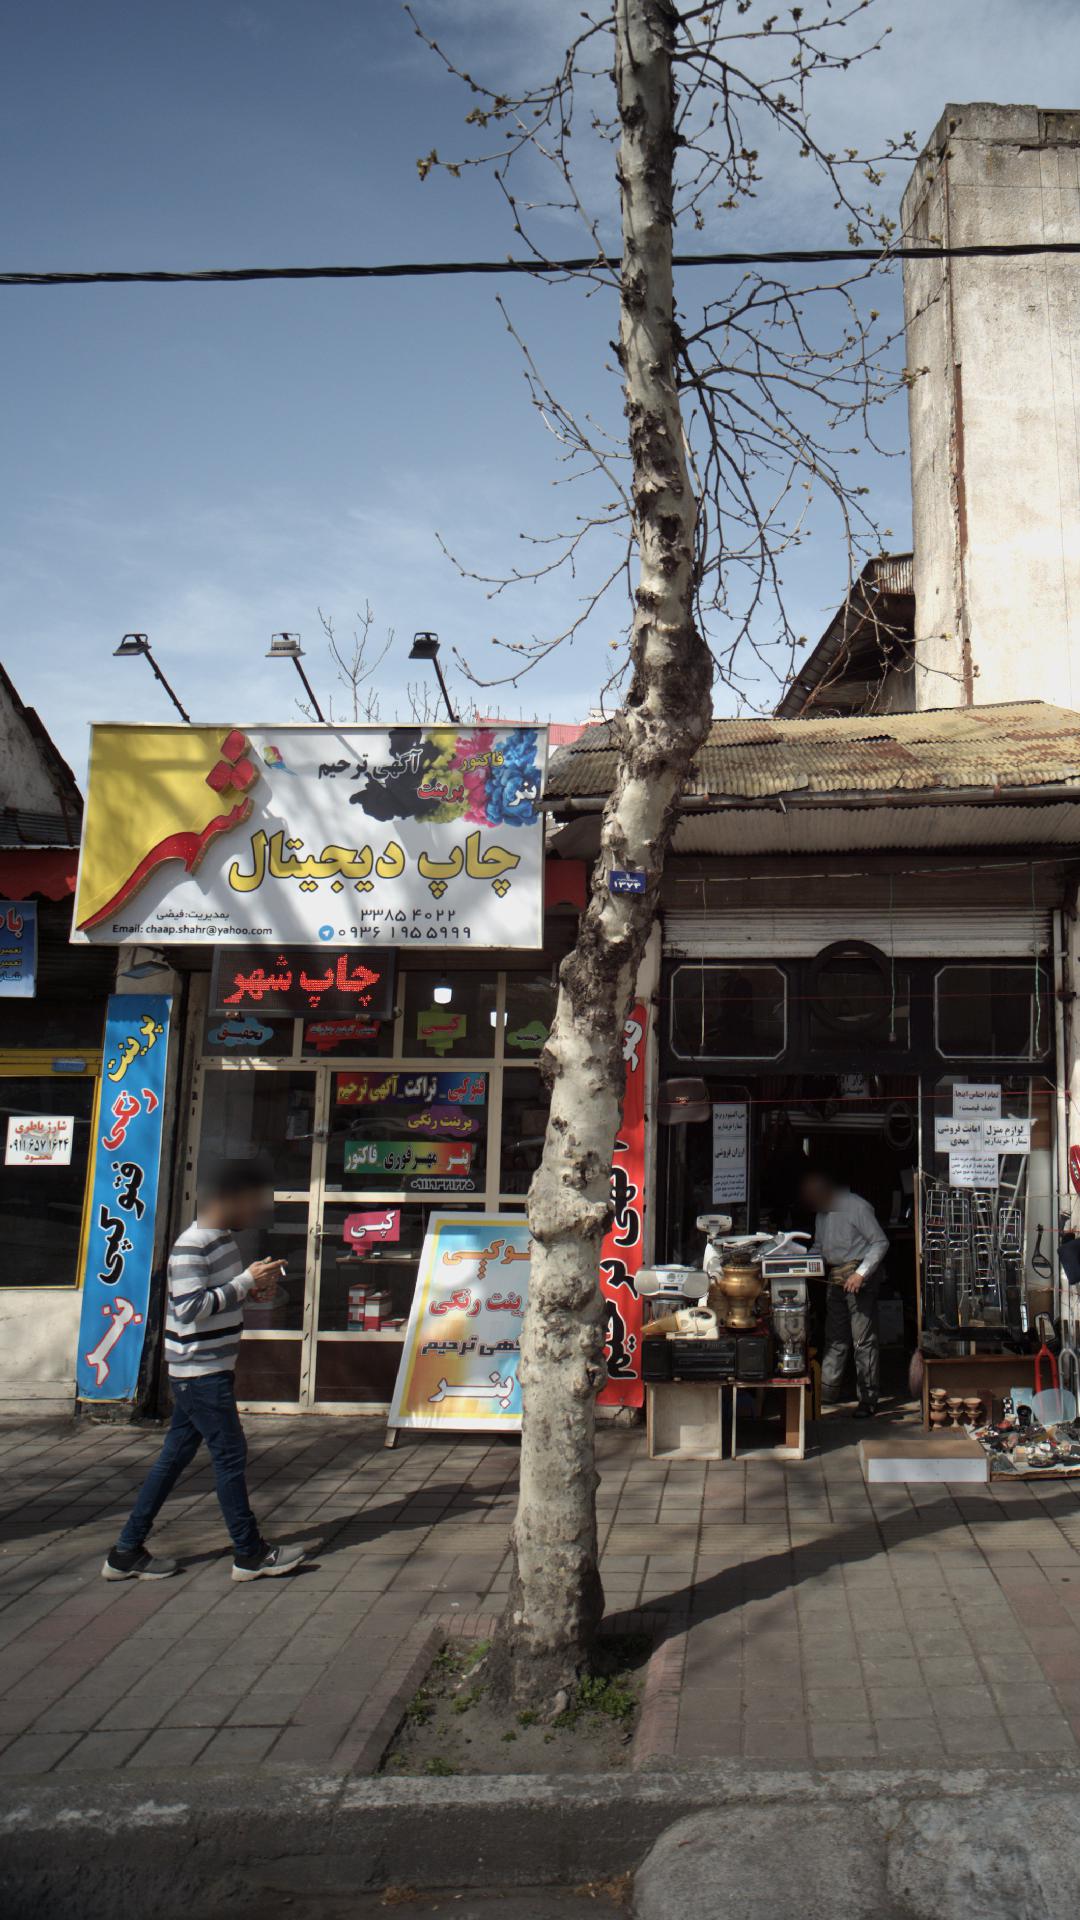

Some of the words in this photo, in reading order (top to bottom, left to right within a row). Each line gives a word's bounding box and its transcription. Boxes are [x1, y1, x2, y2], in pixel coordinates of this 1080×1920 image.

[318, 754, 368, 780] ترحیم
[372, 748, 423, 780] آگهی
[460, 751, 504, 771] فاکتور
[509, 781, 537, 807] بنر
[228, 829, 405, 893] دیجیتال
[417, 830, 521, 899] چاپ
[112, 924, 144, 934] Email:
[145, 924, 273, 937] chaap.shahr@yahoo.com
[223, 954, 293, 1004] شهر
[300, 953, 381, 1008] چاپ
[107, 1014, 164, 1083] پرینت
[337, 1076, 368, 1102] ترحیم
[369, 1074, 400, 1102] آگهی
[404, 1075, 438, 1102] تراکت
[102, 1088, 159, 1151] رنگی
[407, 1112, 438, 1130] رنگی
[439, 1115, 473, 1132] پرینت
[344, 1144, 378, 1170] فاکتور
[350, 1209, 396, 1239] کپی
[428, 1288, 482, 1318] رنگی
[85, 1297, 143, 1387] بنر
[421, 1335, 479, 1357] ترحیم
[428, 1370, 515, 1409] بنر
